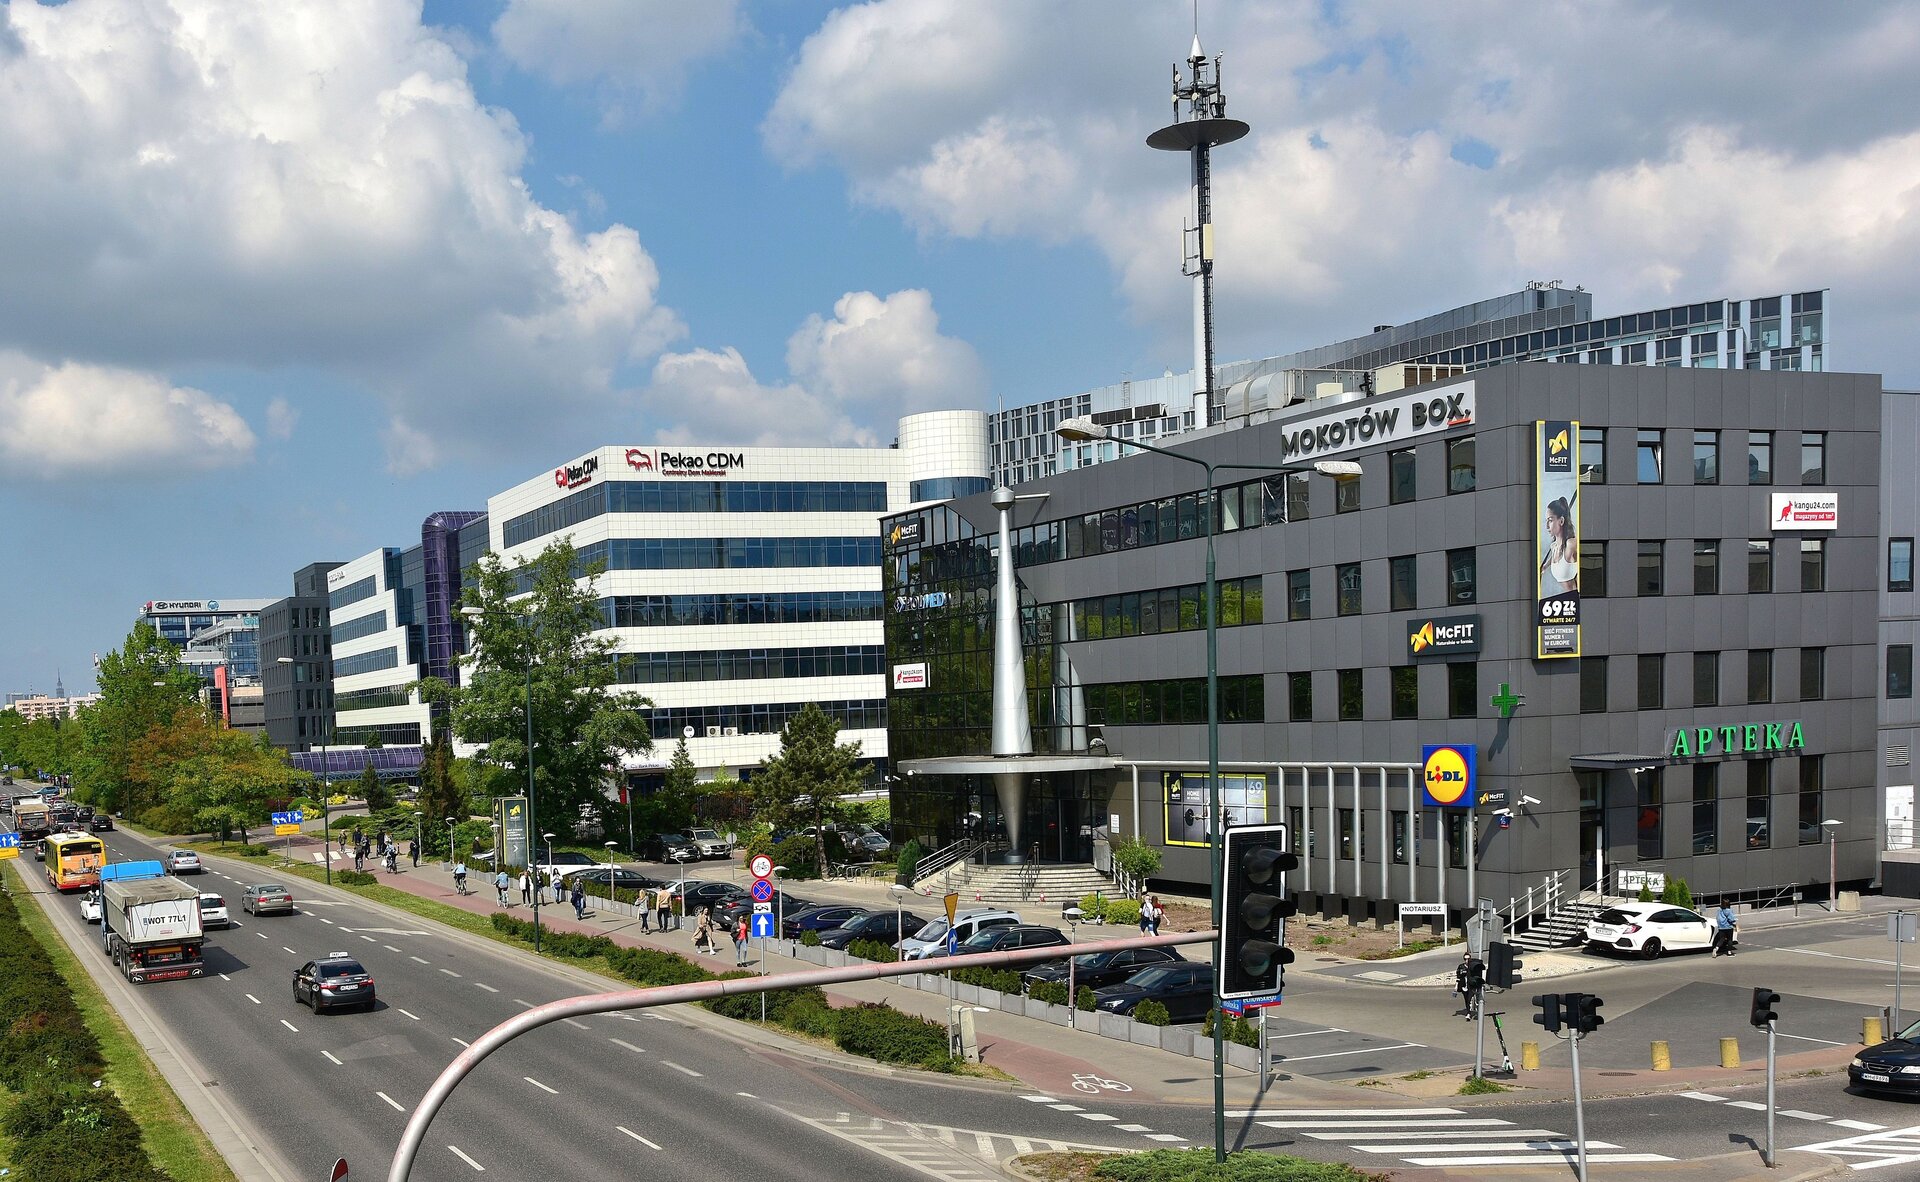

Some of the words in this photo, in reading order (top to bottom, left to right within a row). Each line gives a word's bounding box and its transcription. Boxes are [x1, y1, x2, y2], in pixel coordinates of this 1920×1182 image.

[1282, 407, 1399, 457] MOKOTÓW
[661, 452, 703, 468] Pekao
[707, 453, 744, 469] CDM
[662, 469, 687, 477] Centralny
[1794, 501, 1835, 510] kangu24.com
[901, 523, 918, 535] McFIT
[169, 601, 201, 609] HYUNDAI
[1542, 600, 1562, 616] 69
[1435, 624, 1474, 639] McFIT
[1672, 722, 1805, 756] APTEKA
[1248, 781, 1262, 794] 69
[1623, 876, 1659, 886] APTEKA
[147, 916, 165, 925] WOT
[168, 914, 186, 923] 77L1
